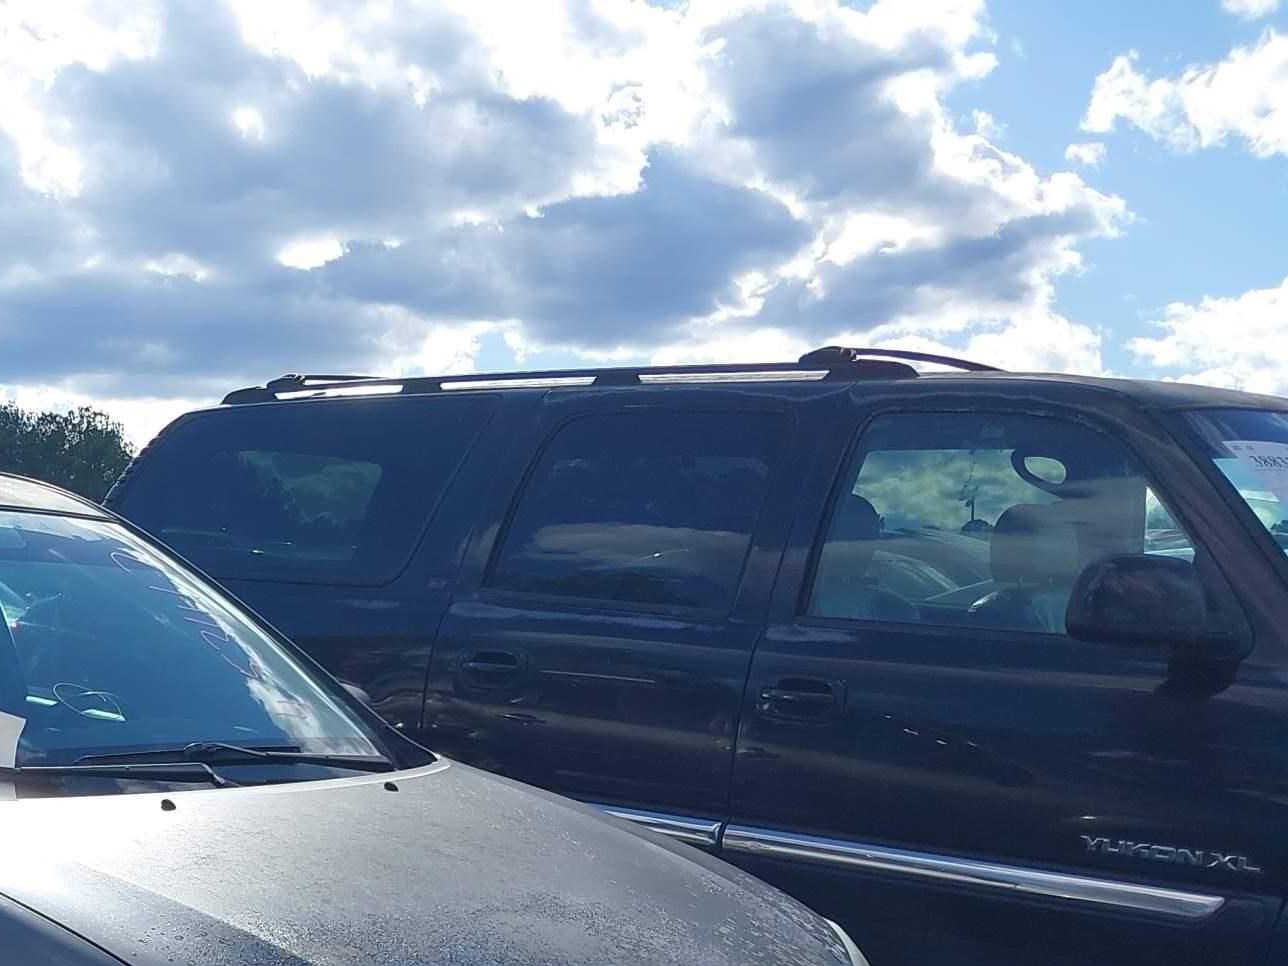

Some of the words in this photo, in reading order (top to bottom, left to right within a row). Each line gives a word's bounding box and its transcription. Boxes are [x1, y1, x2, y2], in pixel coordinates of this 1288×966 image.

[1249, 455, 1288, 469] 3883
[1080, 835, 1205, 864] YUKON
[1207, 852, 1262, 873] XL
